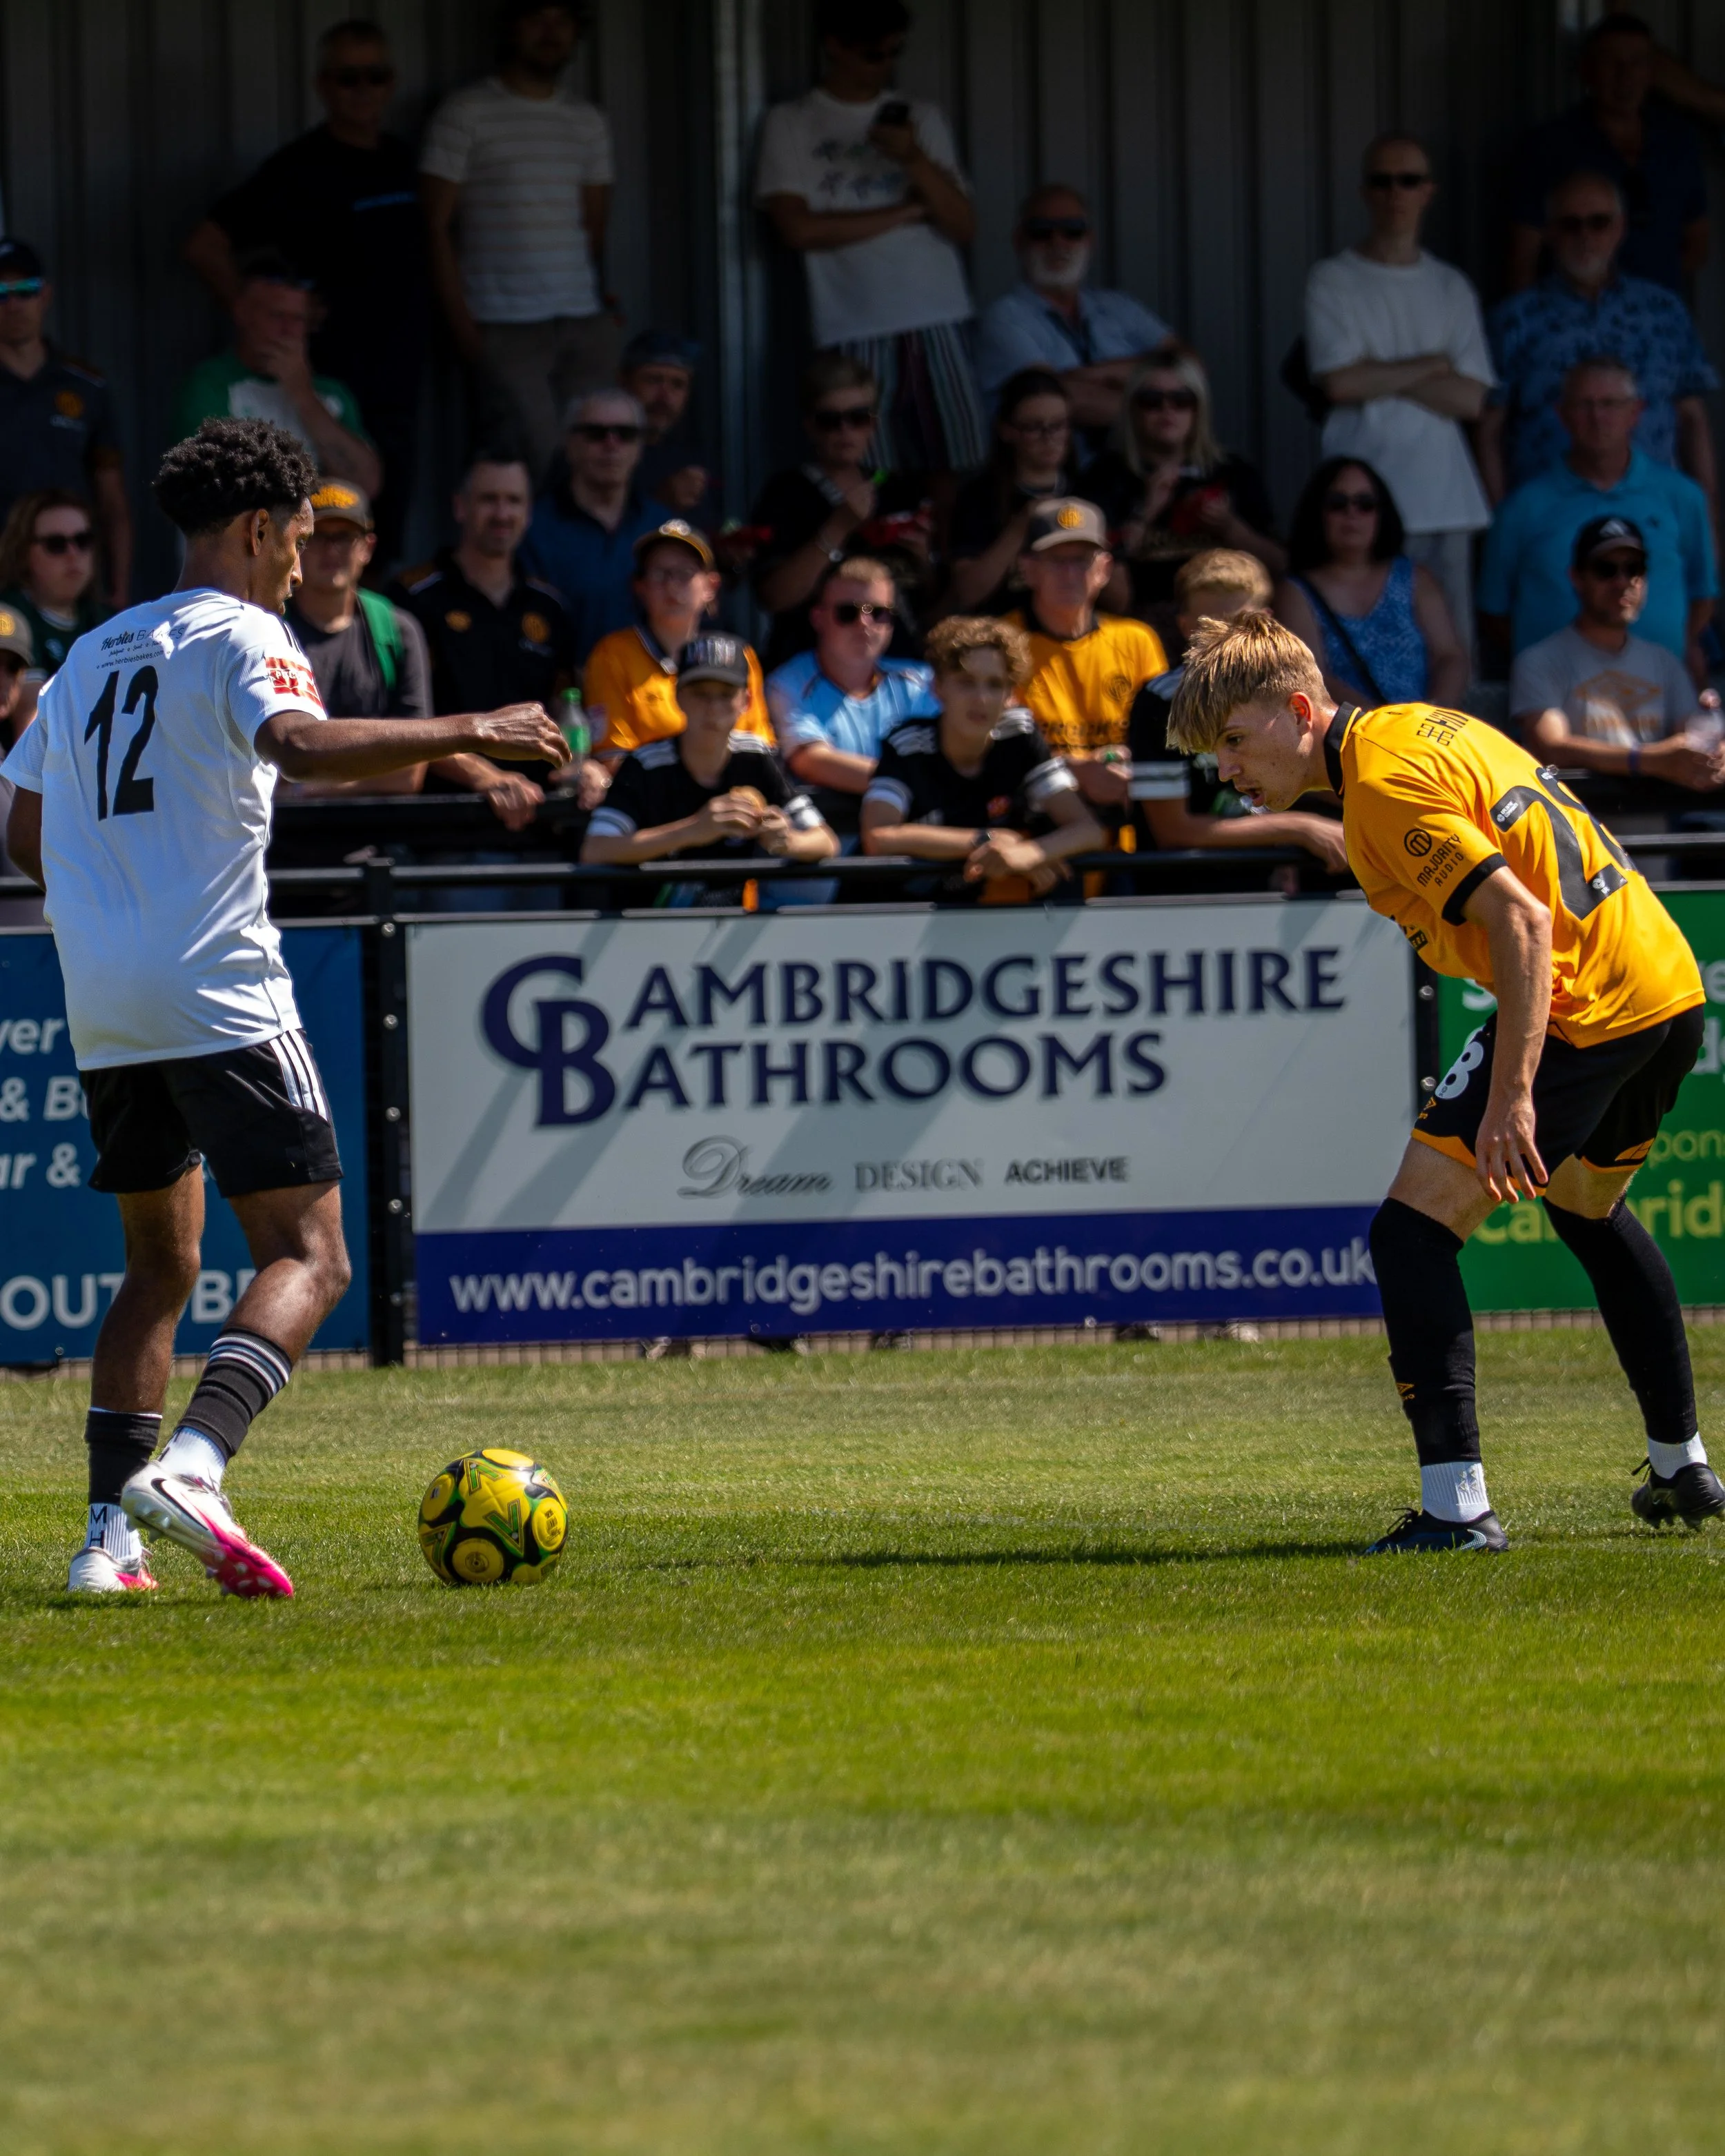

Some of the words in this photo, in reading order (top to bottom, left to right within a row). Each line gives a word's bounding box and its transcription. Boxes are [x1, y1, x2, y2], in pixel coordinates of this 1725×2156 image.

[101, 631, 135, 651] Herbies
[83, 665, 159, 822] 12
[1417, 833, 1462, 887] MAJORITY
[1435, 852, 1464, 887] AUDIO
[482, 949, 1346, 1070] CAMBRIDGESHIRE
[534, 998, 1166, 1127] BATHROOMS
[43, 1074, 90, 1122] B
[46, 1142, 81, 1189] &
[676, 1134, 831, 1199] Dream
[854, 1157, 985, 1193] DESIGN
[1005, 1156, 1128, 1185] ACHIEVE
[449, 1235, 1378, 1316] www.cambridgeshirebathrooms.co.uk
